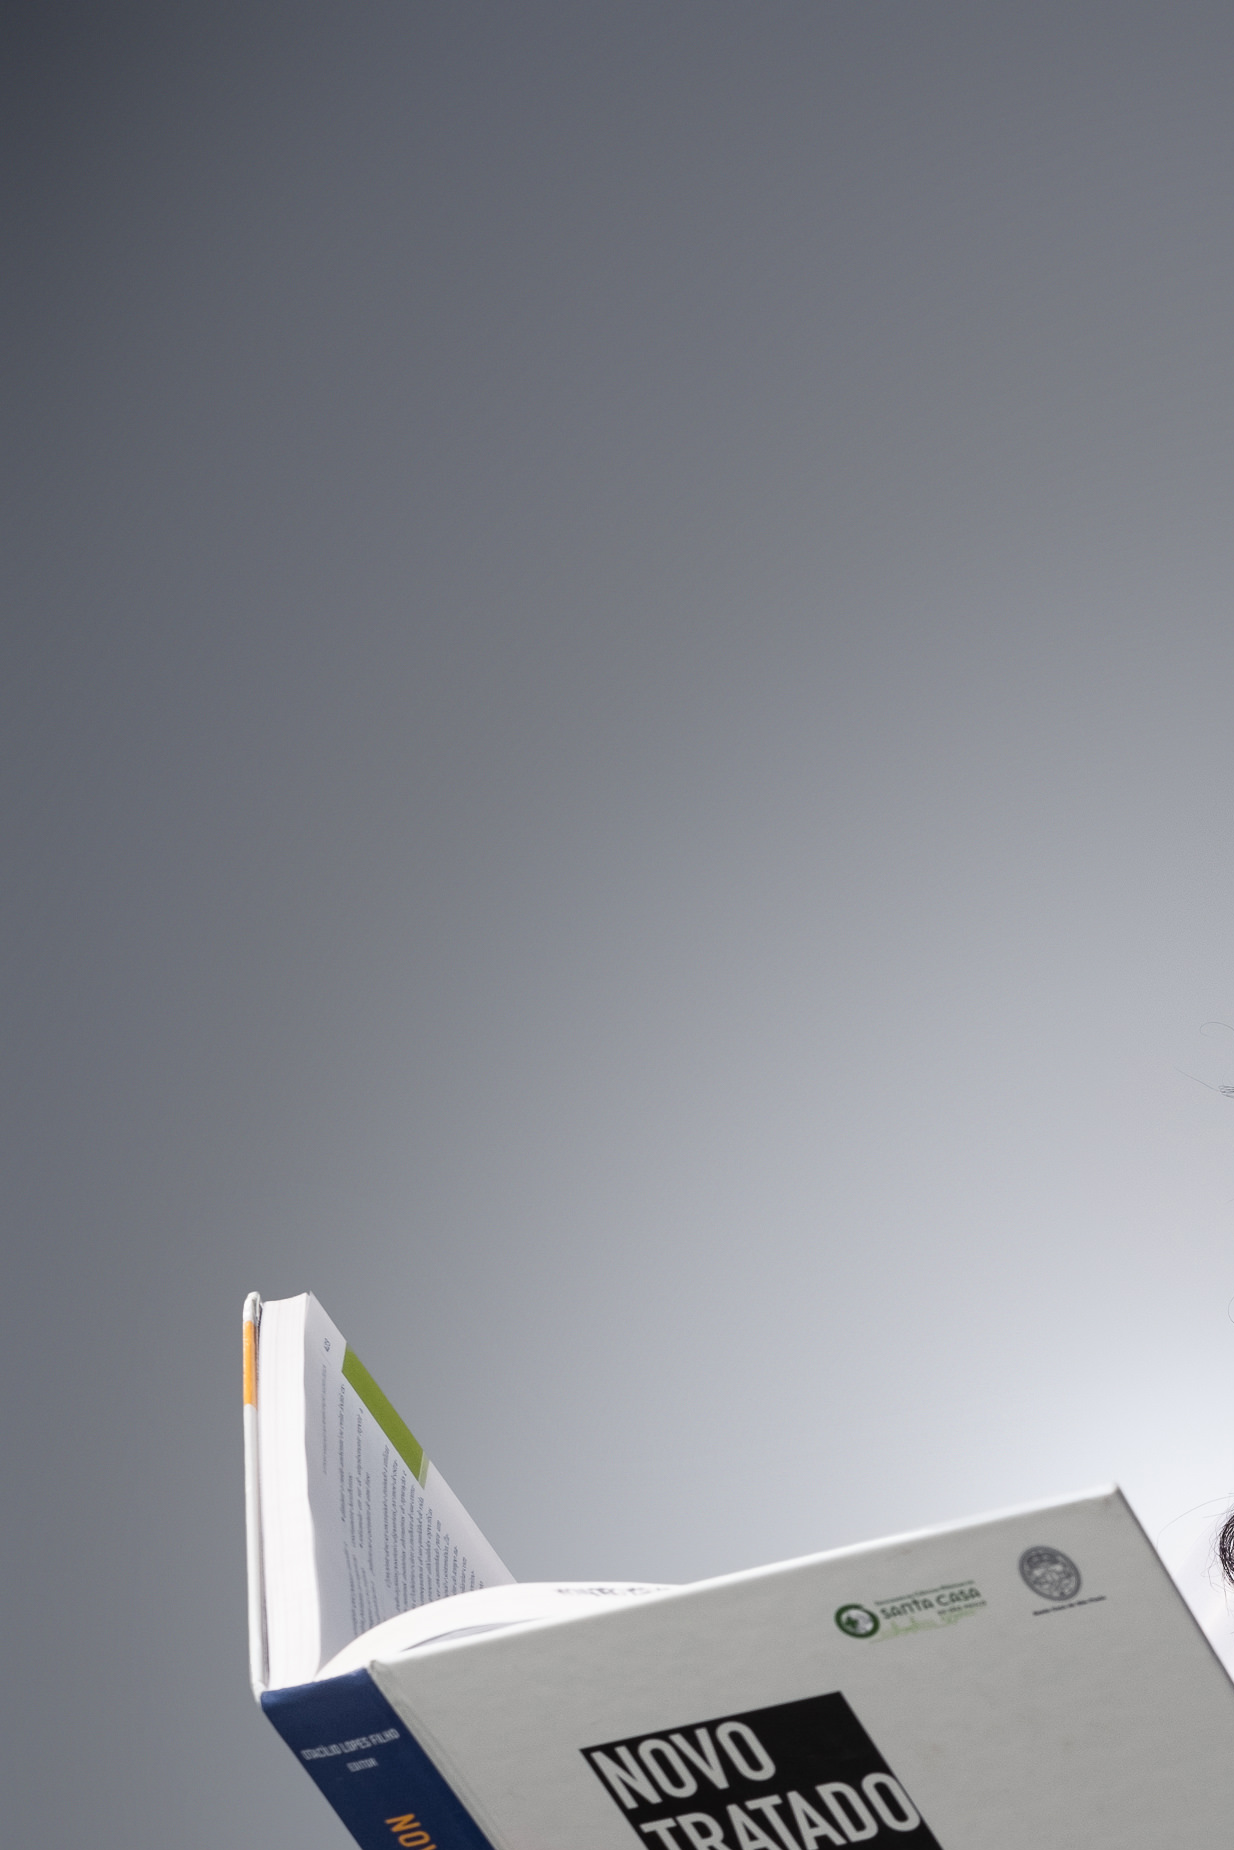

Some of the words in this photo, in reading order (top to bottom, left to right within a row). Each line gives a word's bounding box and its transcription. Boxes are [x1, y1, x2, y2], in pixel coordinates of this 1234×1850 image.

[339, 1737, 372, 1753] LOPES
[368, 1728, 400, 1745] FILHO
[591, 1720, 776, 1809] NOVO
